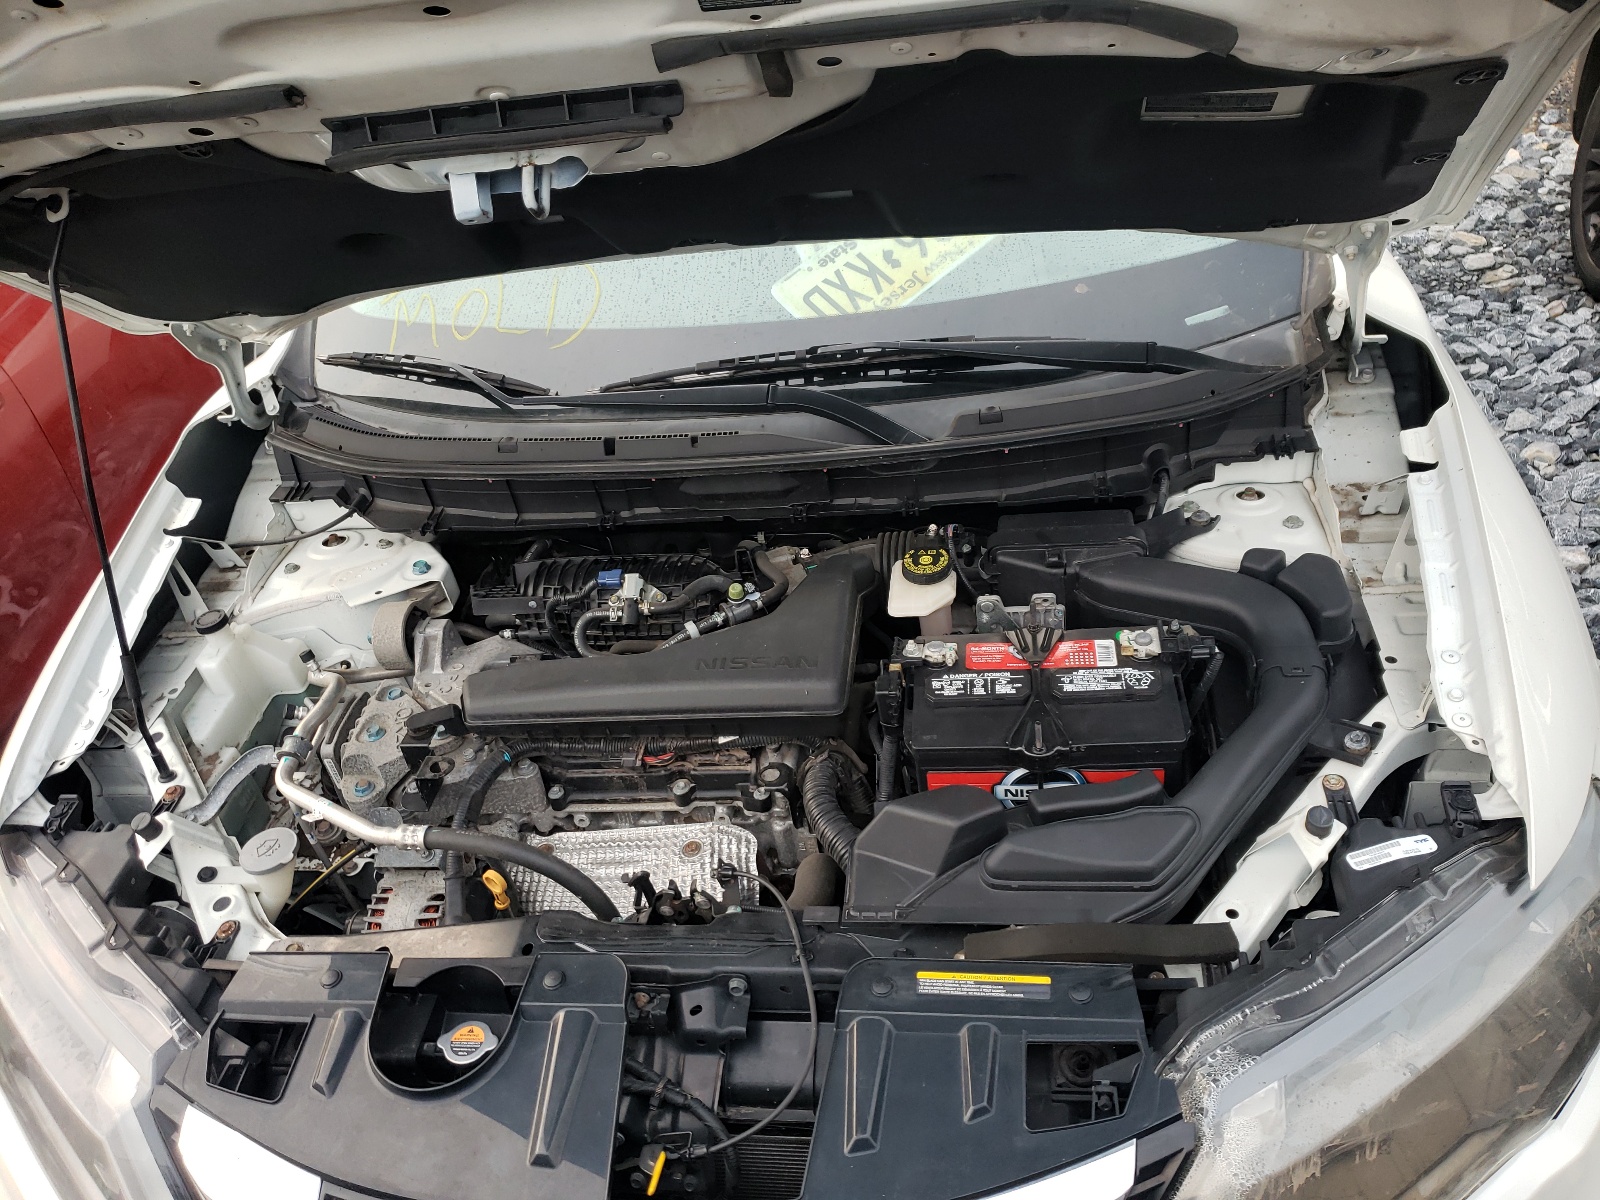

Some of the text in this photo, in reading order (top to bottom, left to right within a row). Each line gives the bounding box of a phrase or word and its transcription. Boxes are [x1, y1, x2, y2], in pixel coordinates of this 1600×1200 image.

[817, 241, 858, 268] State
[802, 252, 895, 319] KXD
[380, 269, 602, 354] MOLD
[695, 656, 819, 671] NISSAN
